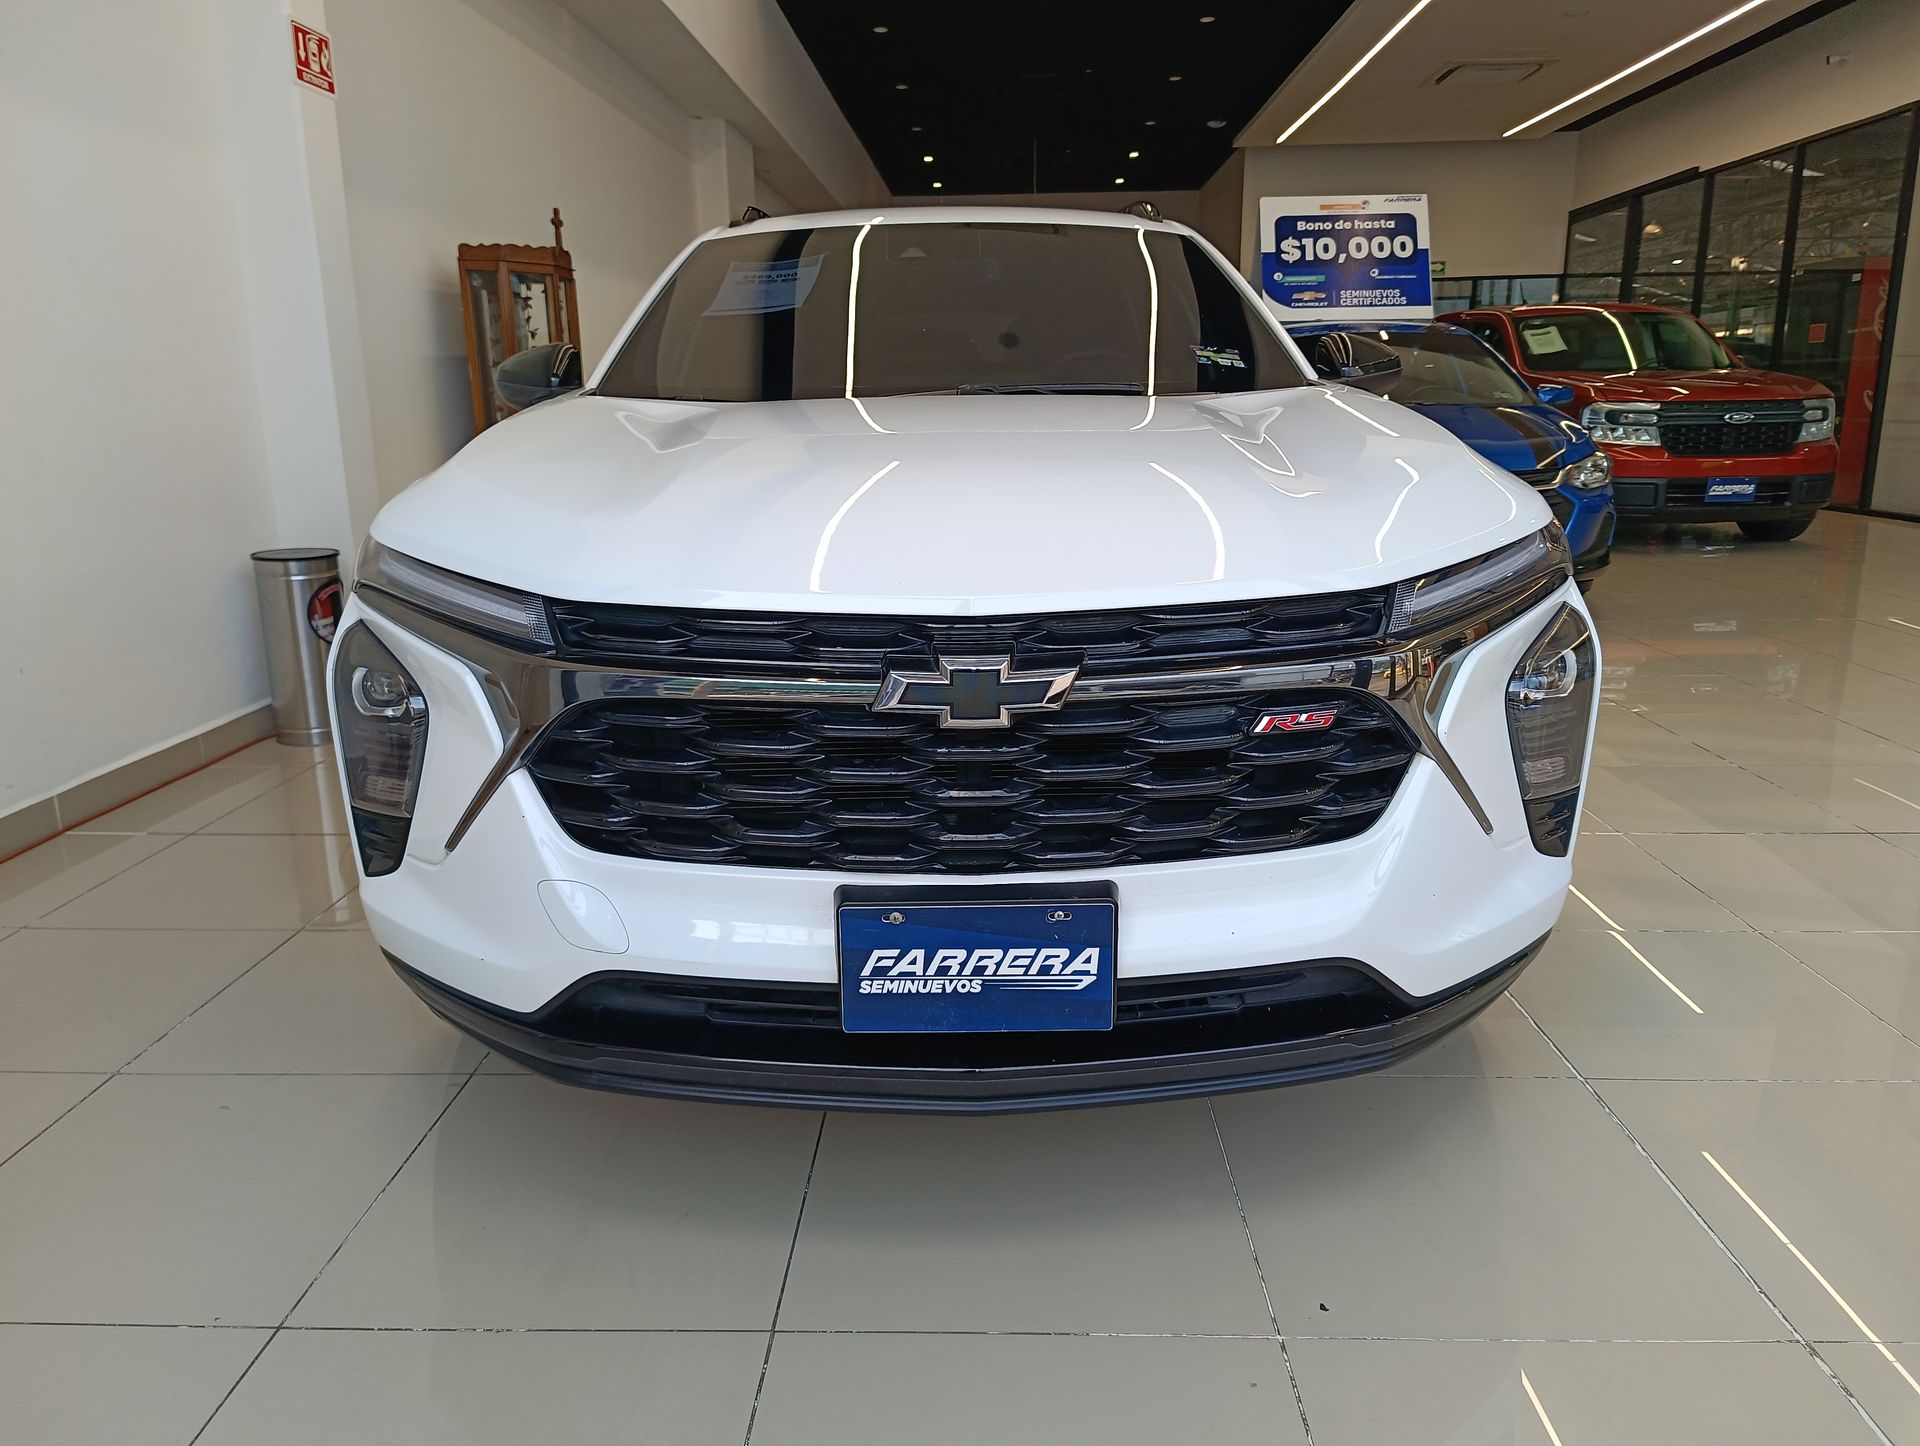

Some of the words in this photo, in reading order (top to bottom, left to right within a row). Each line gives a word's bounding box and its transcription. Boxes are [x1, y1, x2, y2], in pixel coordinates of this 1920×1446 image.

[1296, 220, 1333, 231] Bono
[1334, 219, 1352, 230] de
[1354, 218, 1396, 230] hasta
[1280, 235, 1414, 264] $10,000
[1340, 289, 1401, 298] SEMINUEVOS
[1340, 297, 1408, 306] CERTIFICADOS
[1253, 710, 1338, 733] RS
[860, 947, 1100, 977] FARRERA
[859, 980, 982, 994] SEMINUEVOS
